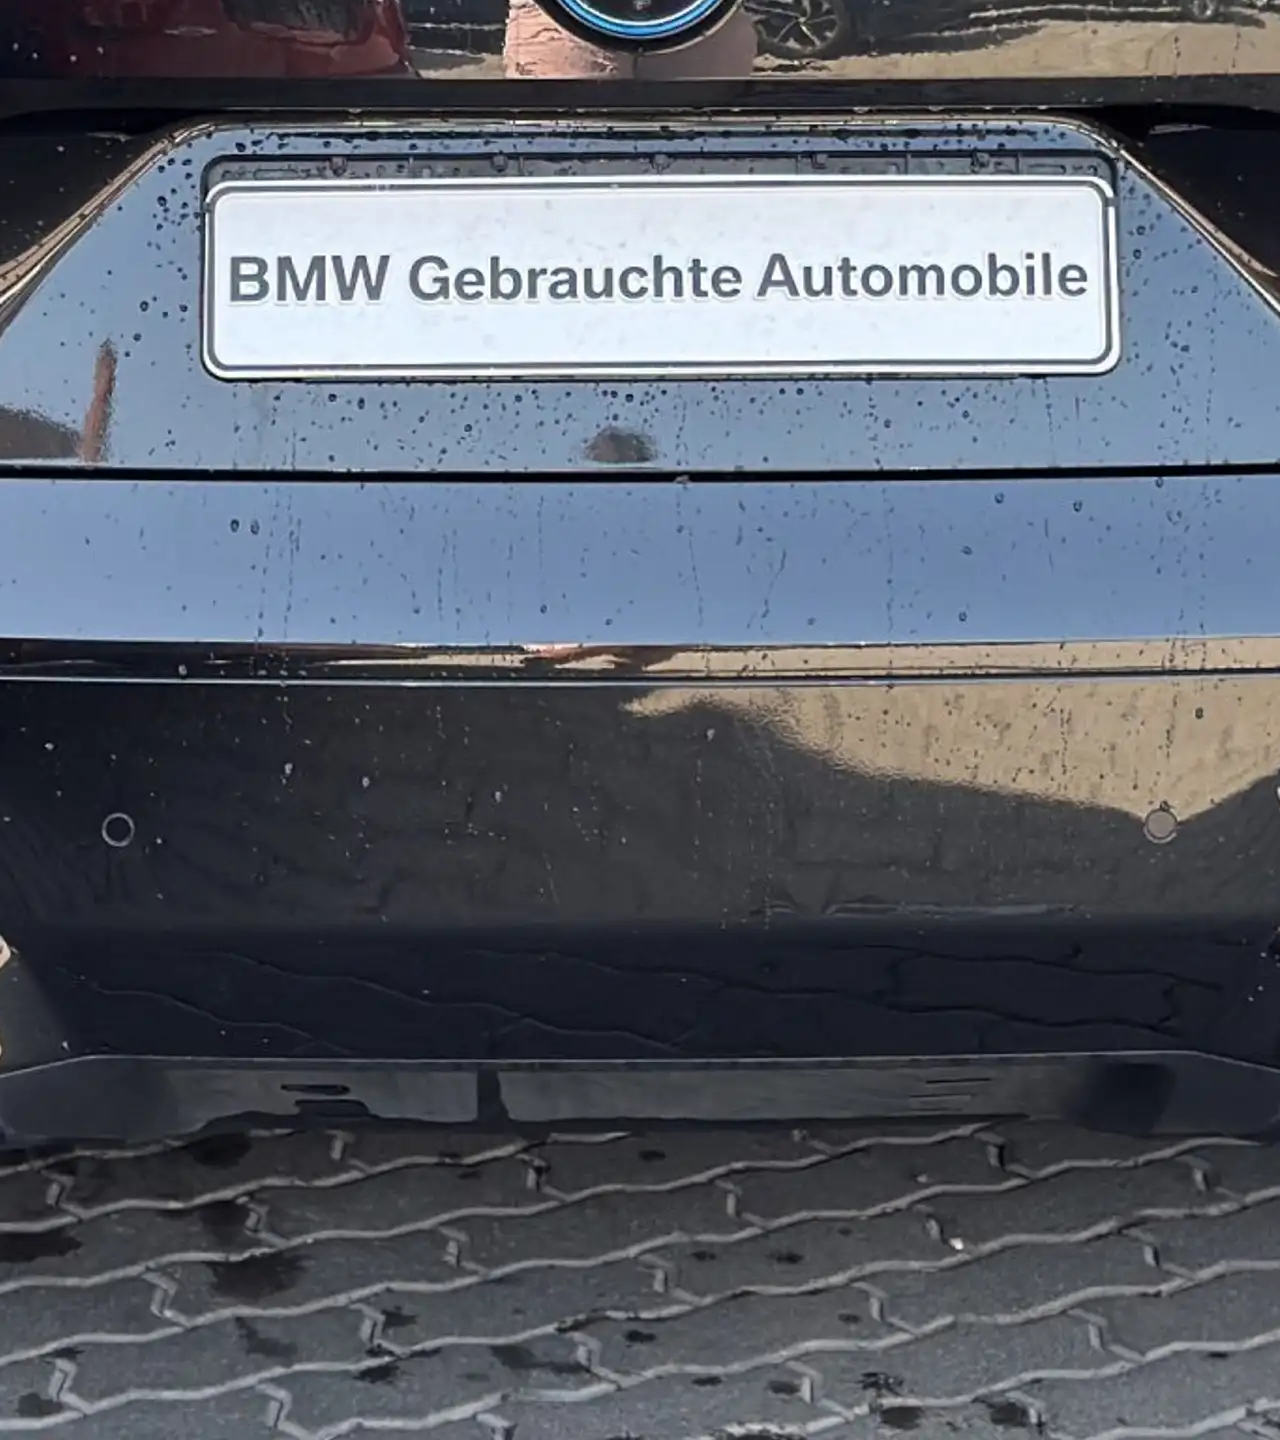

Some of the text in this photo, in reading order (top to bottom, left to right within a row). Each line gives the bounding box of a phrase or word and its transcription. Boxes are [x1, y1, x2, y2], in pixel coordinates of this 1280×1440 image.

[229, 252, 1088, 302] BMW Gebrauchte Automobile
